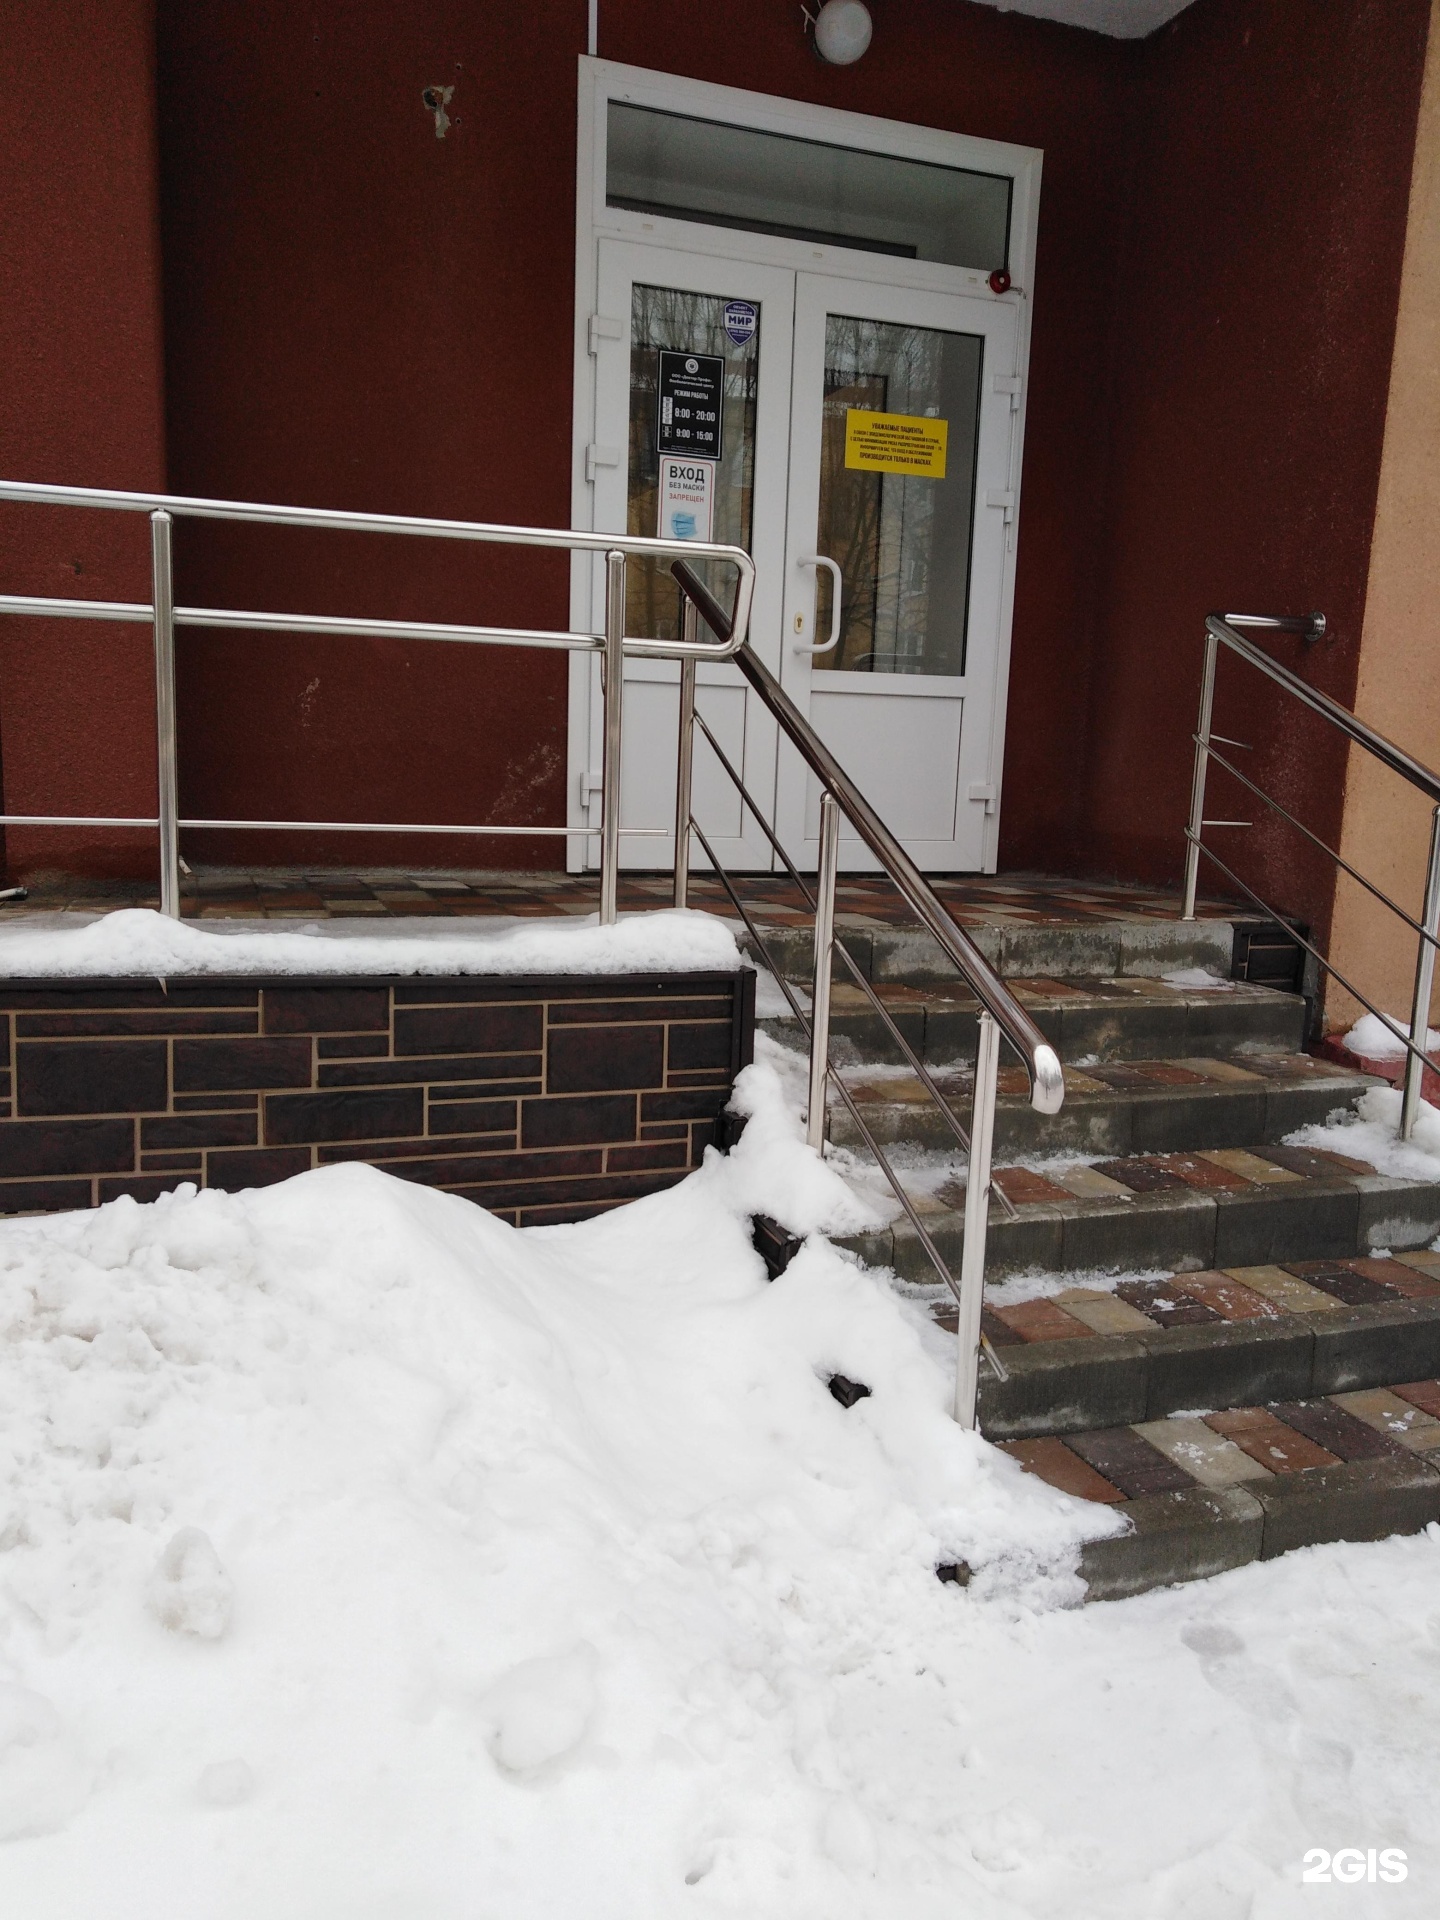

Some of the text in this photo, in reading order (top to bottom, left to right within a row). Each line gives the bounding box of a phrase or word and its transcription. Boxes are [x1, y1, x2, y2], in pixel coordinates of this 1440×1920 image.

[728, 315, 752, 325] МИР
[674, 389, 709, 400] РЕЖИМ РАБОТЫ
[674, 407, 690, 419] 8:00
[696, 410, 716, 422] 20:00
[872, 422, 923, 435] УВАЖАЕМЫЕ ПАЦИЕНТЫ
[676, 428, 690, 439] 9:00
[696, 431, 714, 442] 15:00
[670, 465, 704, 484] ВХОД
[669, 481, 705, 492] БЕЗ МАСКИ
[669, 493, 704, 503] ЗАПРЕЩЕН
